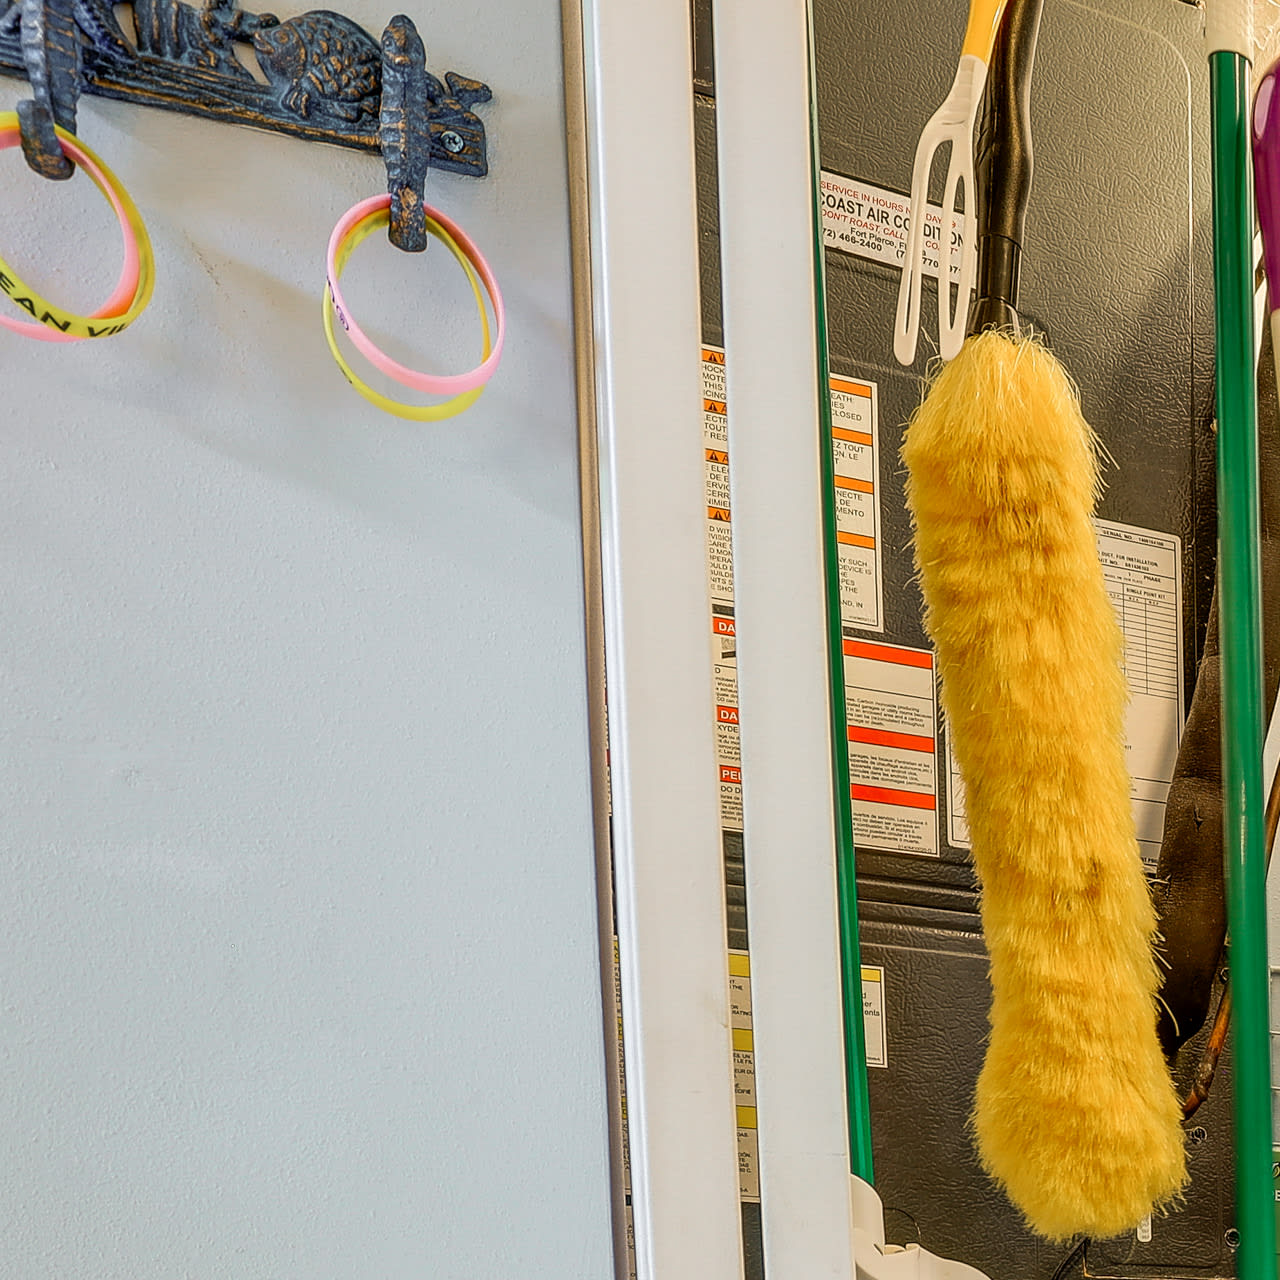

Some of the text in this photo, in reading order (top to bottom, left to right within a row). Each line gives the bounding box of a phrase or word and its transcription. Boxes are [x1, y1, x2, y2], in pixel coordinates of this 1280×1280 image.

[820, 181, 859, 199] SERVICE
[861, 193, 870, 203] IN
[872, 196, 903, 212] HOURS
[866, 207, 889, 226] AIR
[850, 217, 880, 234] ROAST,
[883, 227, 904, 240] CALL
[850, 227, 897, 248] Fort Pierce,
[839, 234, 883, 252] 466-2400
[844, 443, 864, 454] TOUT
